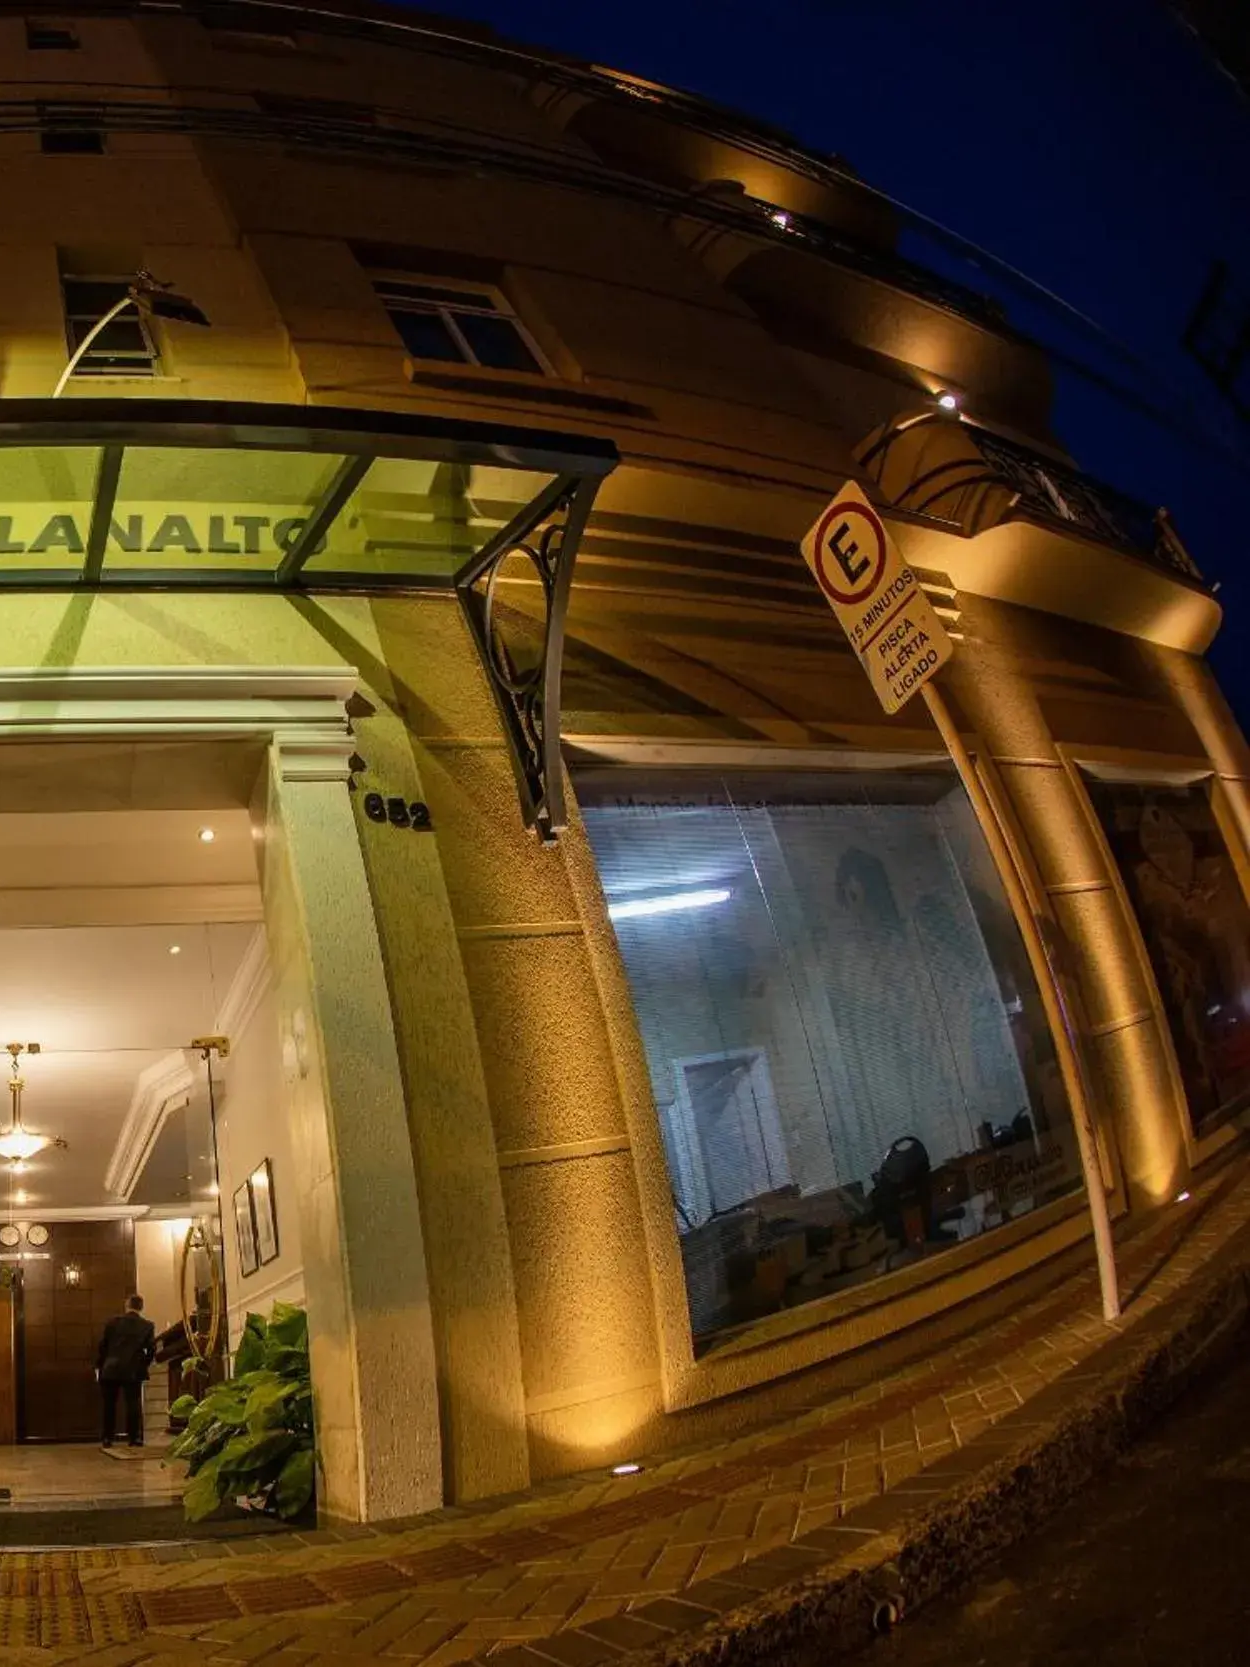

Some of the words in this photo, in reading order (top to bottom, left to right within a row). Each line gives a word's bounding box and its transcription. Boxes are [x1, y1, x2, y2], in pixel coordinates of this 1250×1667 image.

[828, 521, 871, 586] E
[849, 624, 863, 644] 15
[863, 569, 914, 629] MINUTOS
[878, 618, 914, 659] PISCA
[884, 631, 930, 680] ALERTA
[892, 649, 938, 699] LIGADO
